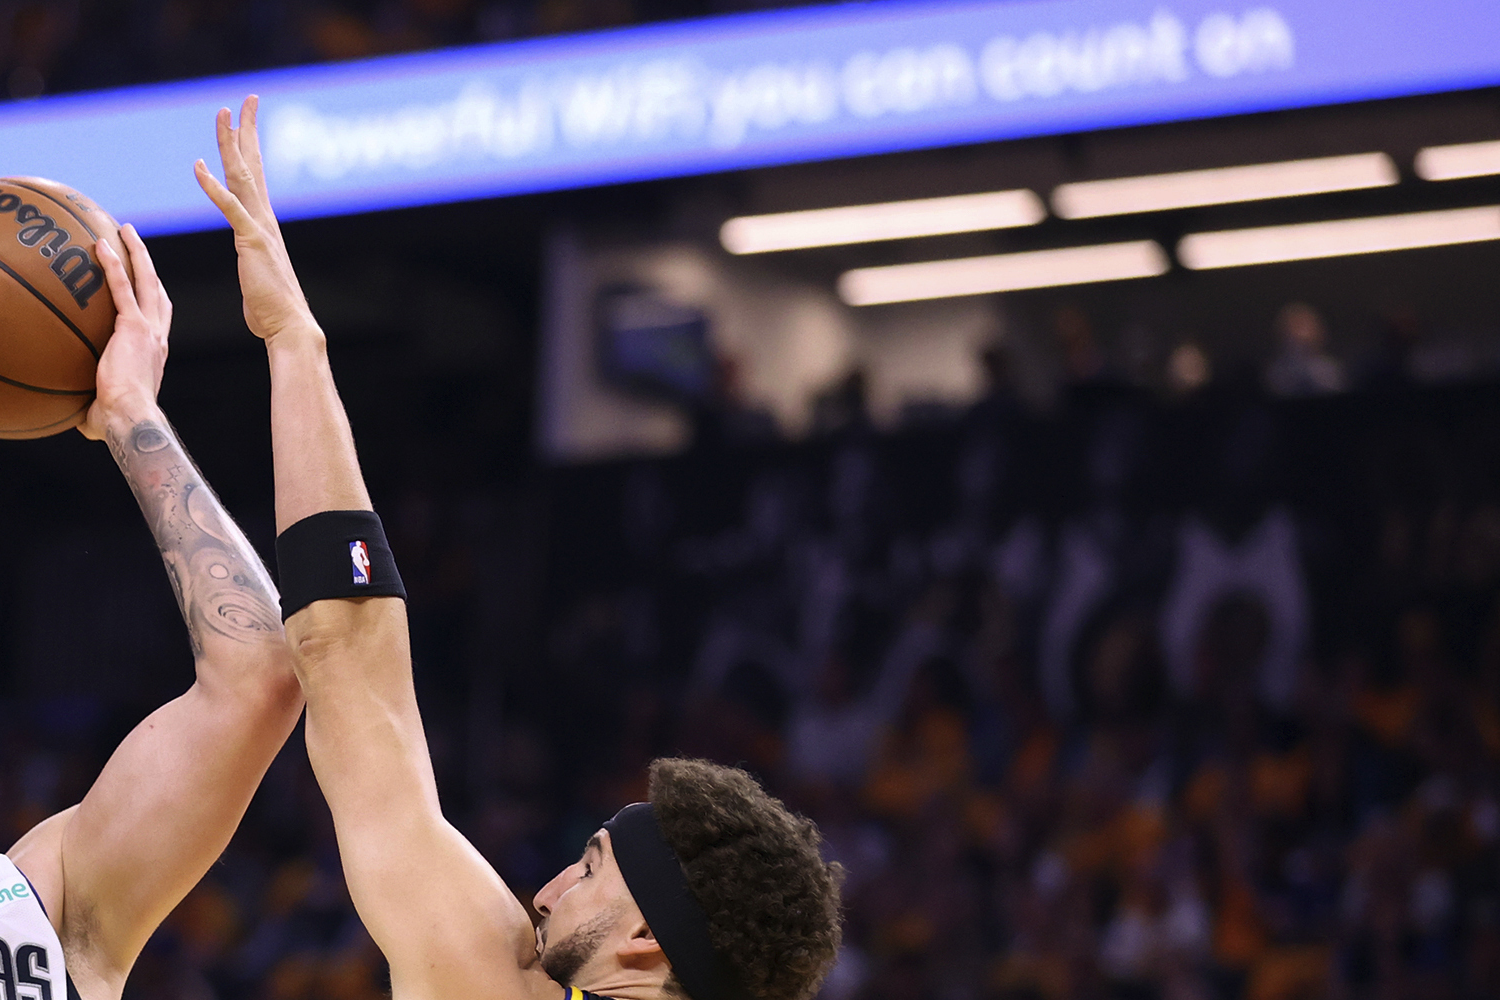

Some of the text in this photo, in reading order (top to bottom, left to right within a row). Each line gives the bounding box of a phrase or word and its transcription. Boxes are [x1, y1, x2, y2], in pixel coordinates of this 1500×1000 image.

[708, 60, 836, 152] you
[840, 42, 975, 119] can
[978, 8, 1190, 103] count
[1193, 8, 1295, 79] on
